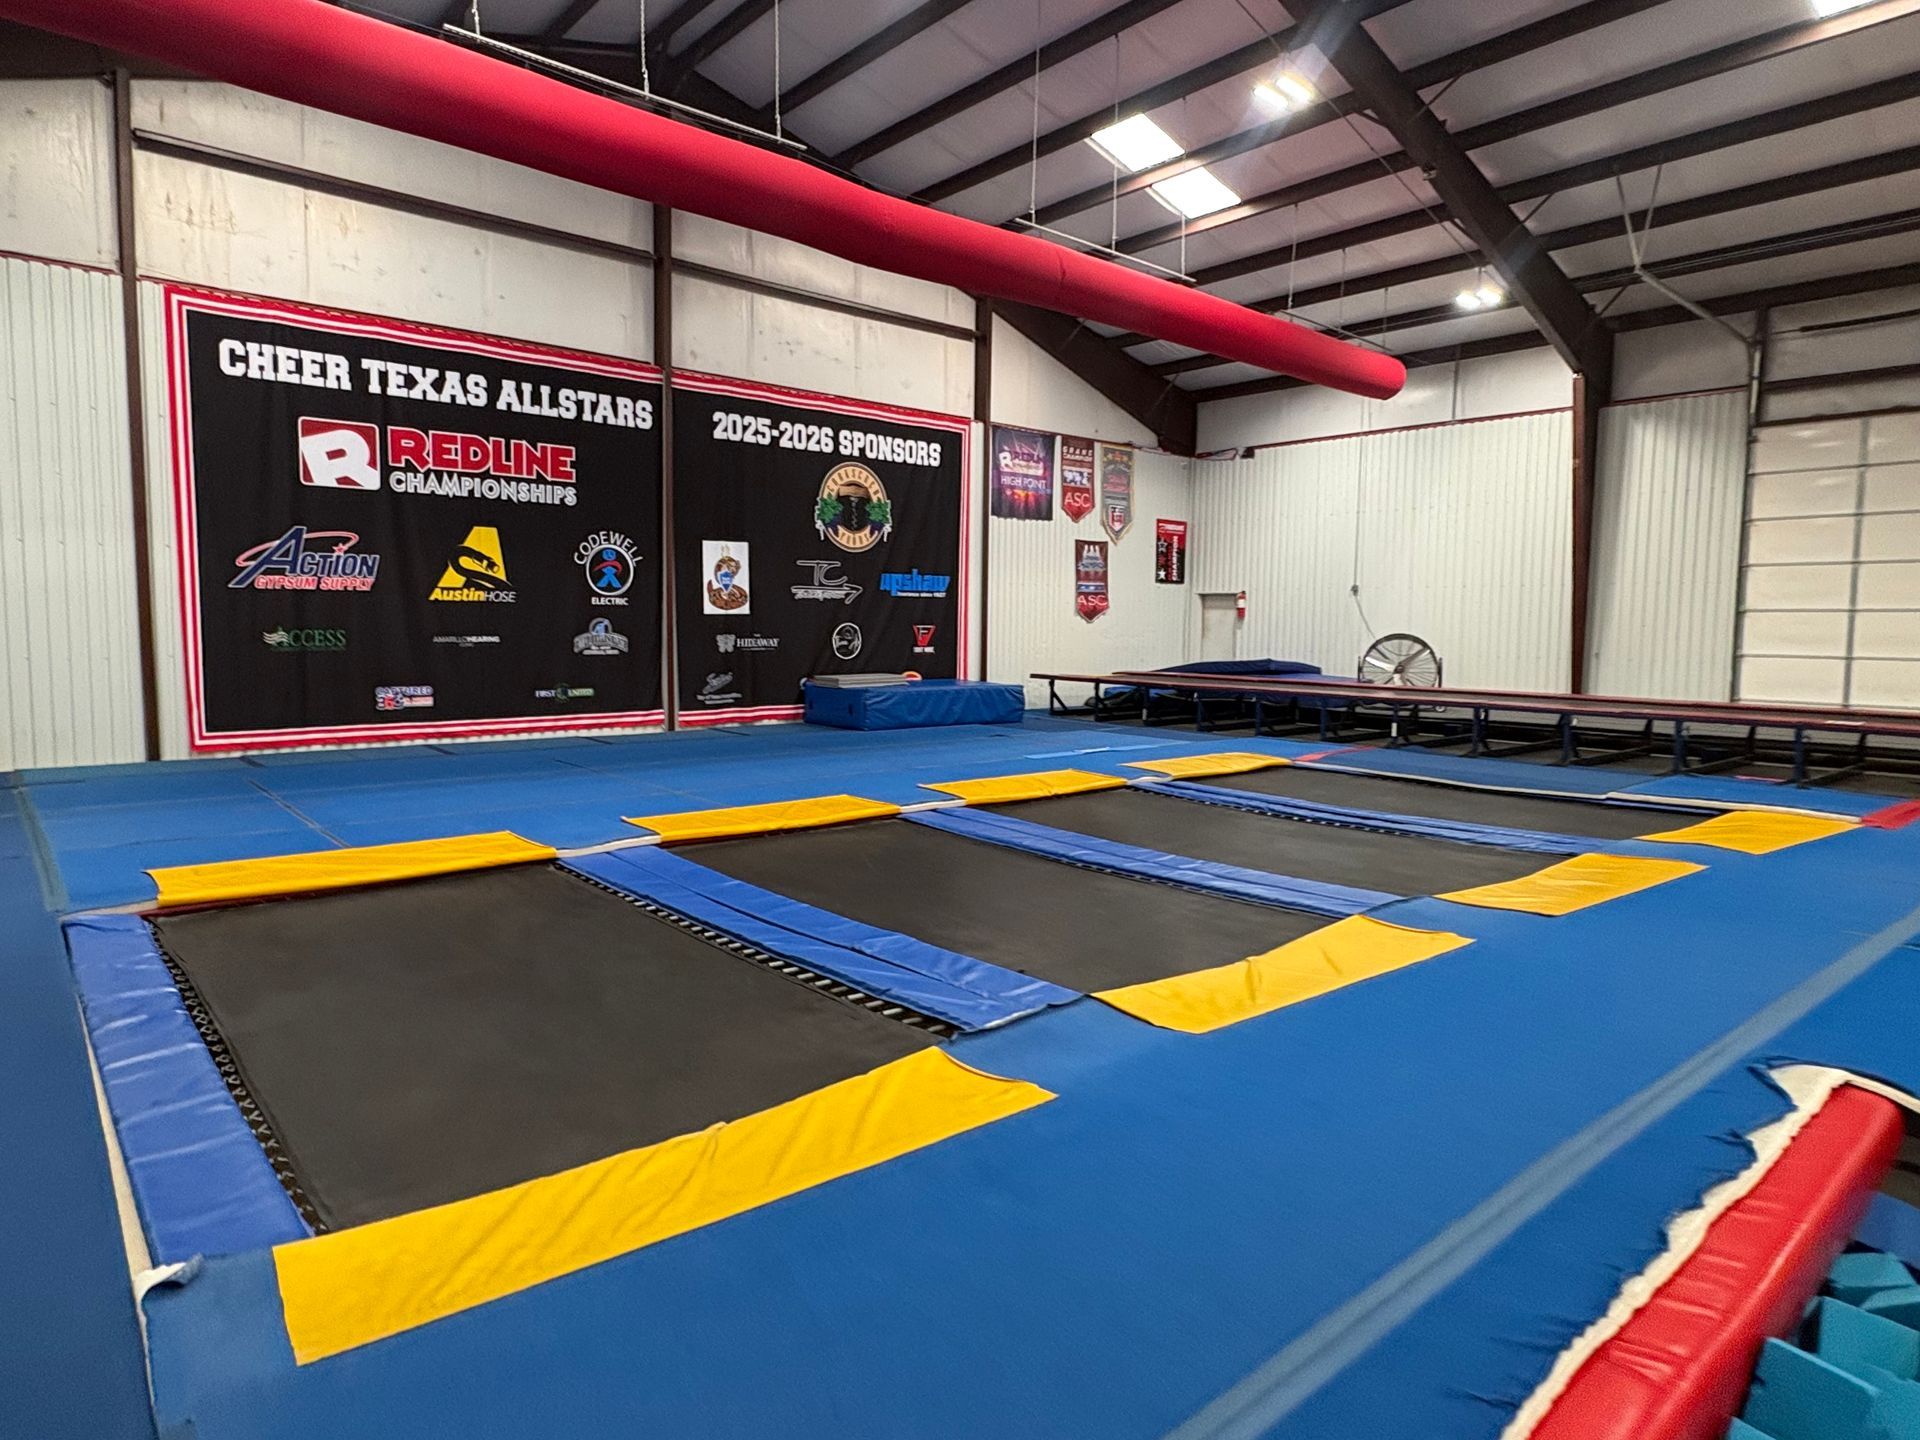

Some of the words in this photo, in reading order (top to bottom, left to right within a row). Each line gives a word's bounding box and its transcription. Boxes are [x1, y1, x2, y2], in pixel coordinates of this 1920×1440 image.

[218, 338, 353, 391] CHEER
[361, 358, 488, 408] TEXAS
[495, 379, 654, 430] ALLSTARS
[387, 425, 577, 482] REDLINE
[712, 411, 835, 454] 2025-2026
[838, 429, 942, 467] SPONSORS
[388, 470, 578, 506] CHAMPIONSHIPS
[1000, 475, 1022, 487] HIGH
[1064, 492, 1091, 508] ASC
[228, 525, 380, 589] ACTION
[573, 530, 644, 567] CODEWELL
[253, 574, 319, 591] GYPSUM
[320, 575, 377, 592] SUPPLY
[795, 559, 848, 586] TC
[879, 568, 951, 597] upshaw
[591, 597, 629, 606] ELECTRIC
[1077, 594, 1108, 606] ASC
